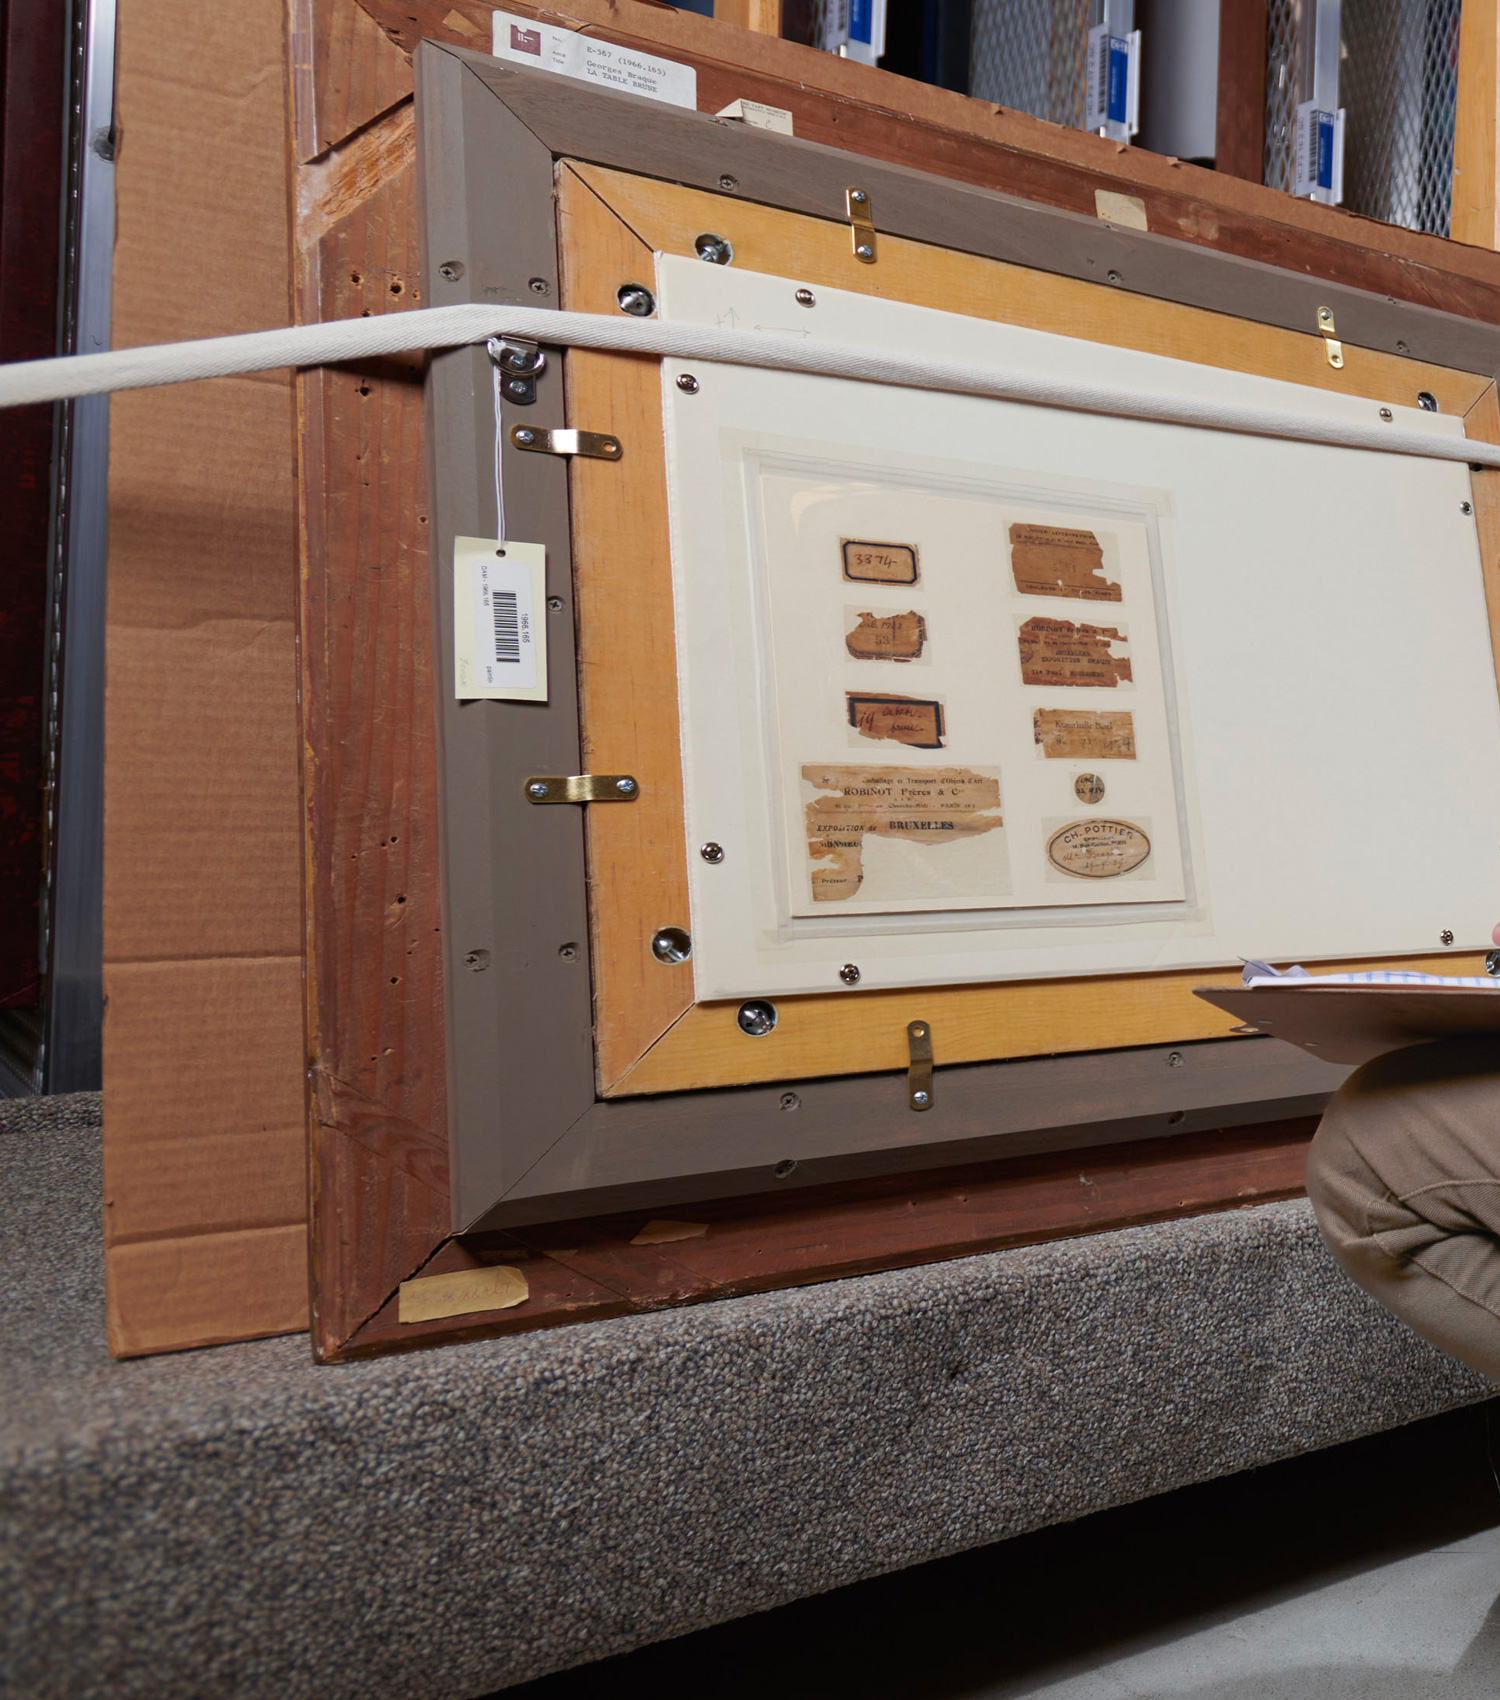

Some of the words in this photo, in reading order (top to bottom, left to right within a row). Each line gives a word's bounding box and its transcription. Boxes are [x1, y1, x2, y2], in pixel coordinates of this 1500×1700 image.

[586, 46, 612, 58] E-567
[618, 57, 666, 77] (1966.165)
[587, 60, 622, 75] Georges
[627, 71, 657, 85] Braque
[587, 68, 597, 76] LA
[602, 72, 628, 85] TABLE
[632, 81, 658, 93] BRUNE
[854, 553, 897, 568] 3374
[521, 613, 531, 644] 1966.165
[907, 777, 937, 785] Transport
[967, 777, 983, 785] d'Art
[843, 788, 892, 796] ROBINOT
[937, 788, 945, 796] &
[867, 824, 877, 832] de
[888, 821, 955, 830] BRUXELLES
[1064, 830, 1082, 844] CH.
[1084, 825, 1134, 840] POTTIER
